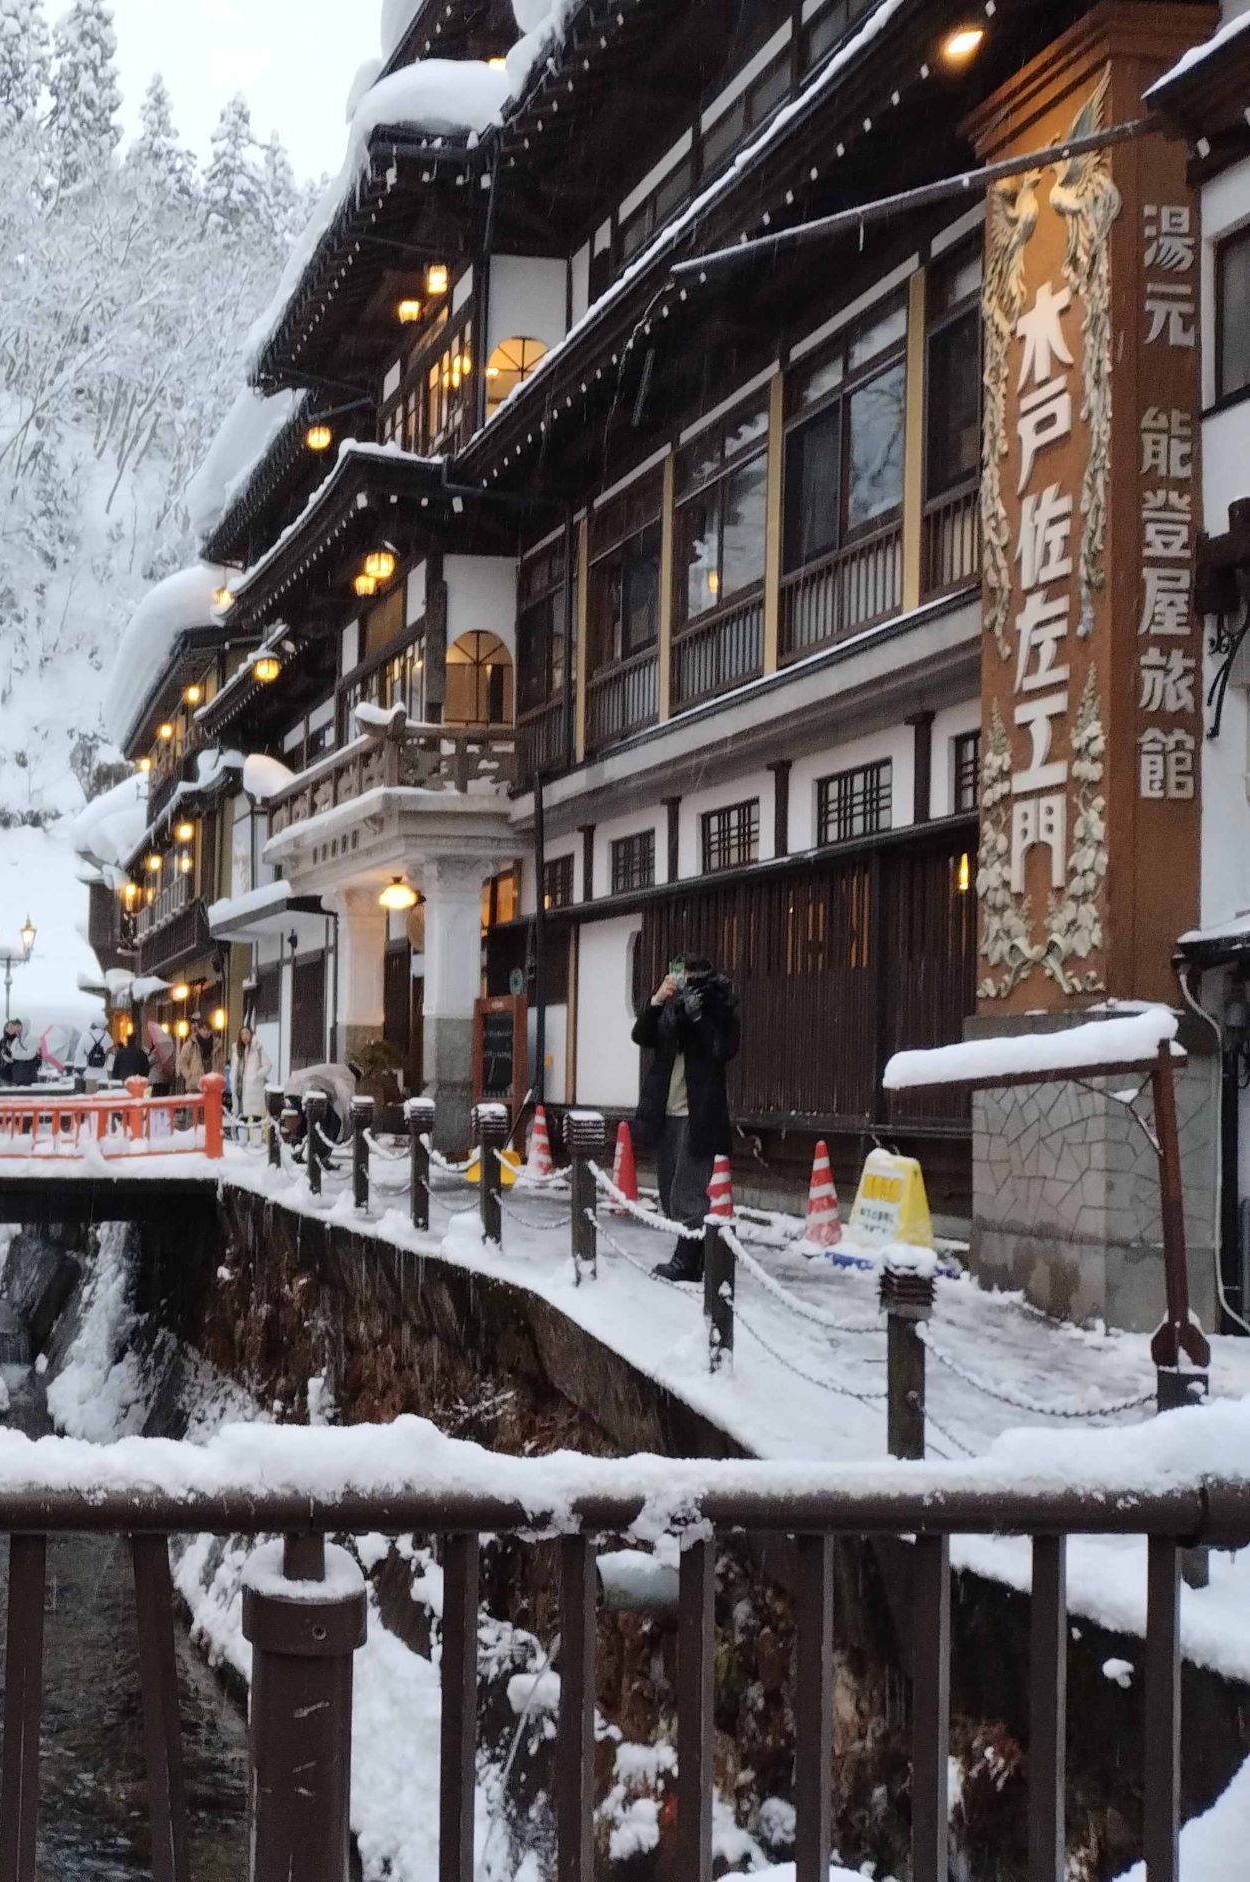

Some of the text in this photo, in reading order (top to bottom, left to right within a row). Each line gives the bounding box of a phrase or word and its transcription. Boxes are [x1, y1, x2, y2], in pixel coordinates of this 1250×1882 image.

[1137, 204, 1196, 800] 湯元 能登屋旅館
